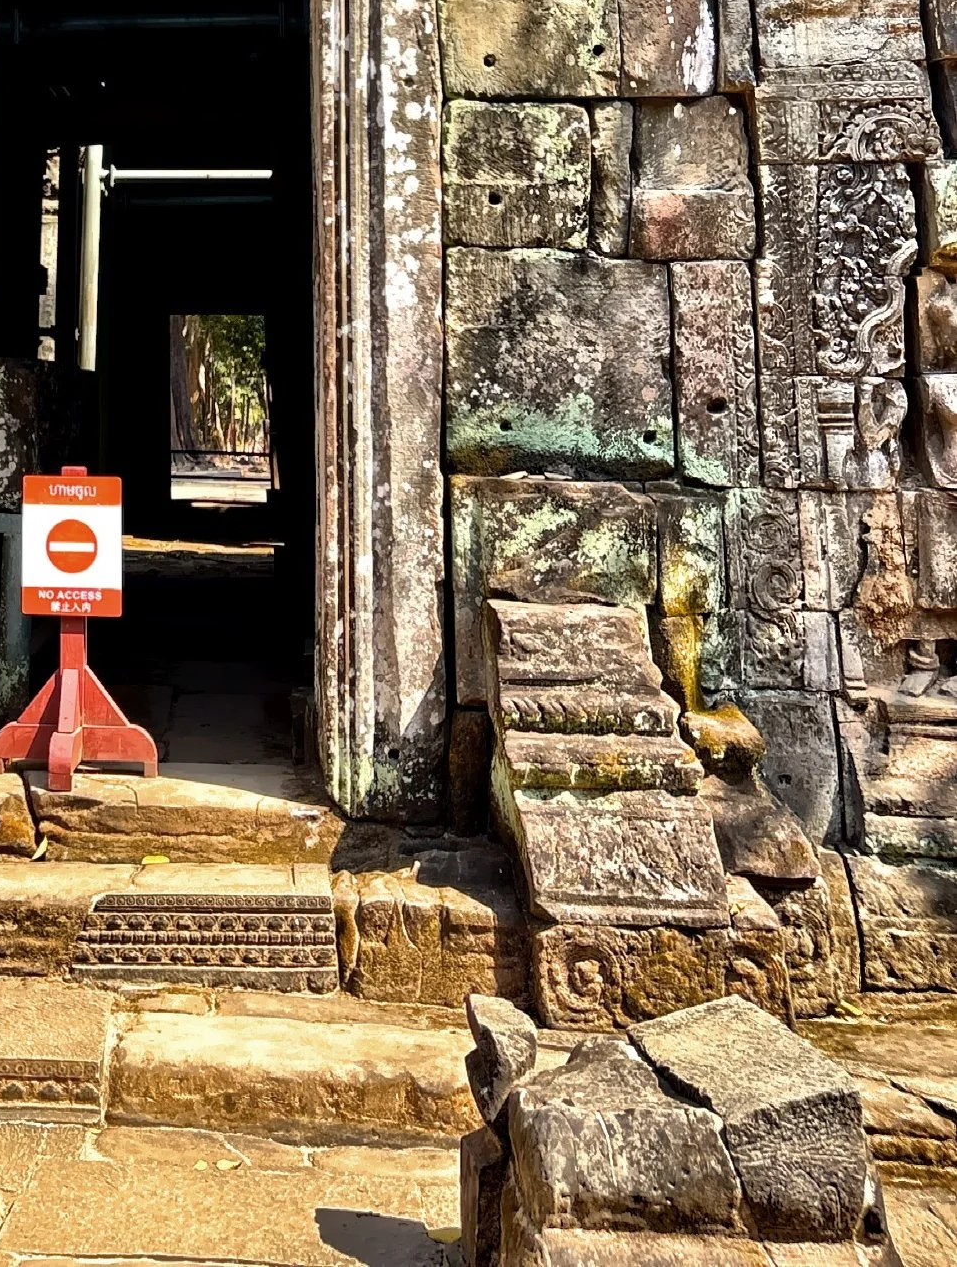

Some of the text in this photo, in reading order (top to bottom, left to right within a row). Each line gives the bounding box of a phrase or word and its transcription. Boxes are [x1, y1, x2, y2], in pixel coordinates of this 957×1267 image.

[38, 590, 102, 601] NO ACCESS
[50, 601, 92, 613] 禁止入内
